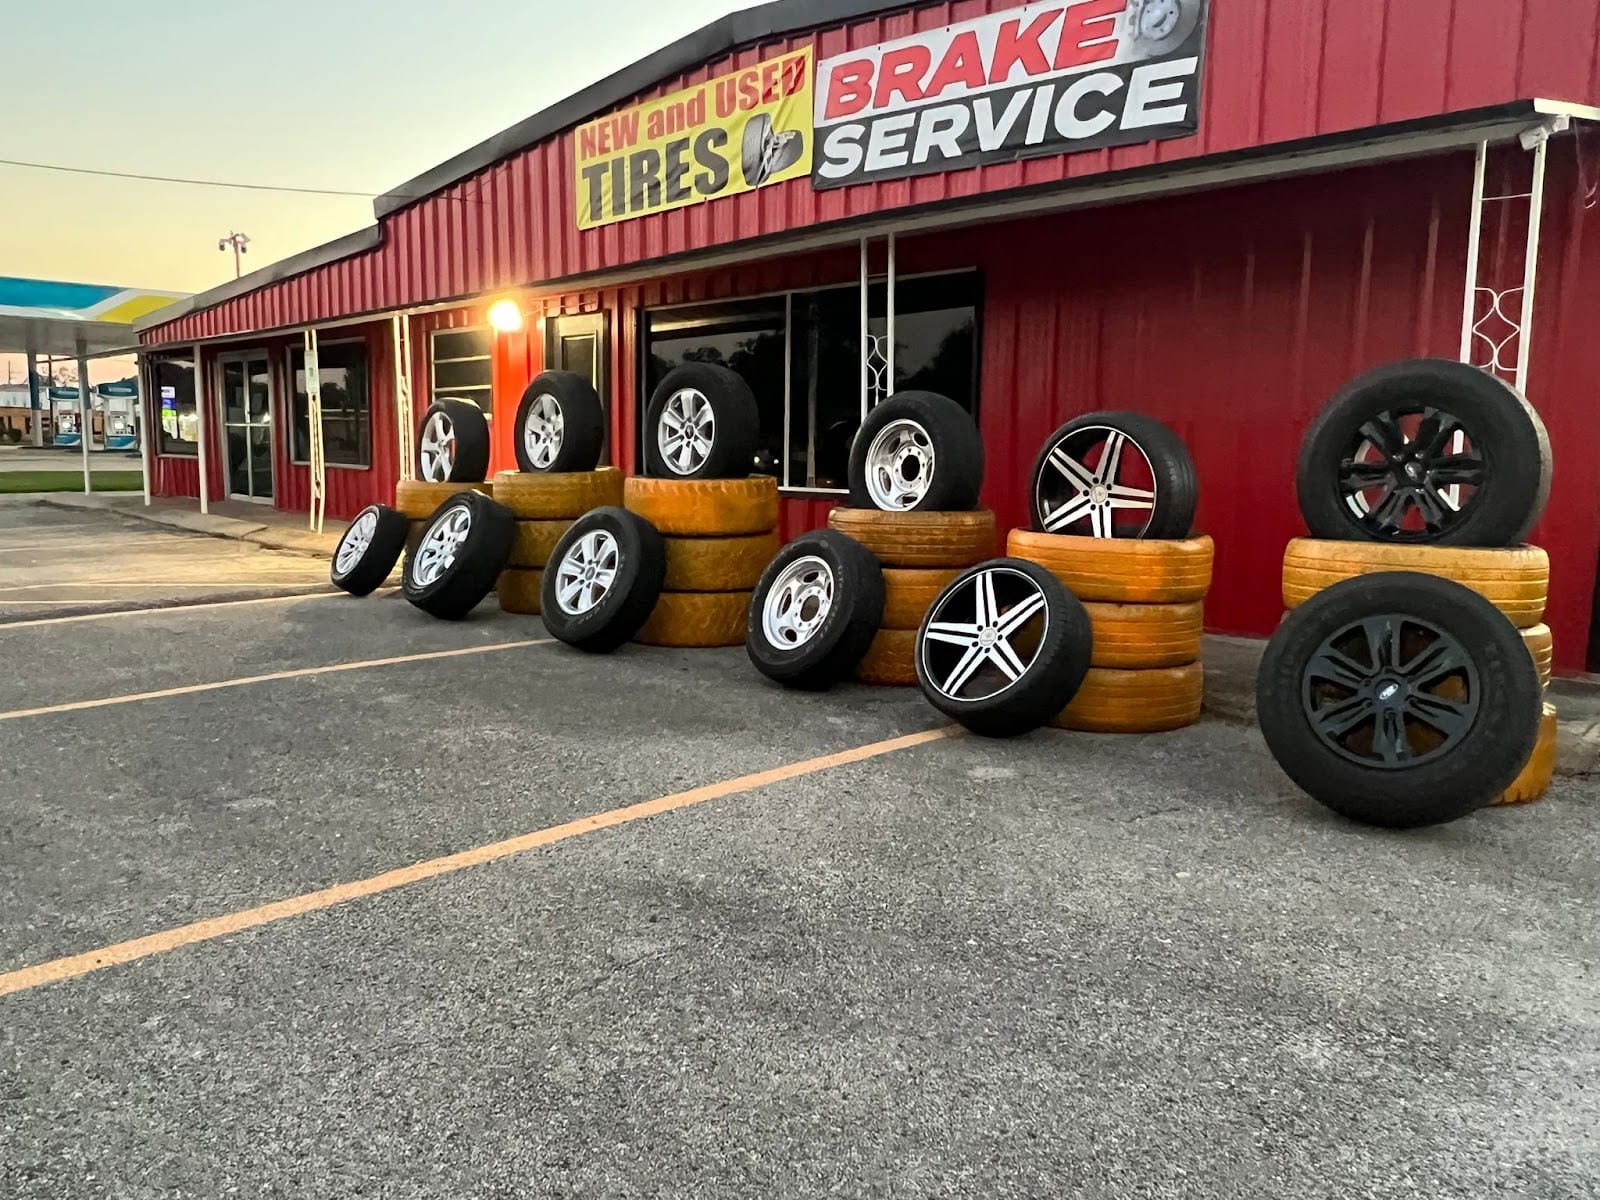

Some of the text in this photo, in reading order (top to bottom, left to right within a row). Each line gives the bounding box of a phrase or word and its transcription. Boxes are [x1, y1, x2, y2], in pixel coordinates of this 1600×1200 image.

[580, 55, 805, 161] NEW and USED
[824, 0, 1127, 120] BRAKE
[818, 56, 1198, 178] SERVICE
[582, 128, 729, 221] TIRES
